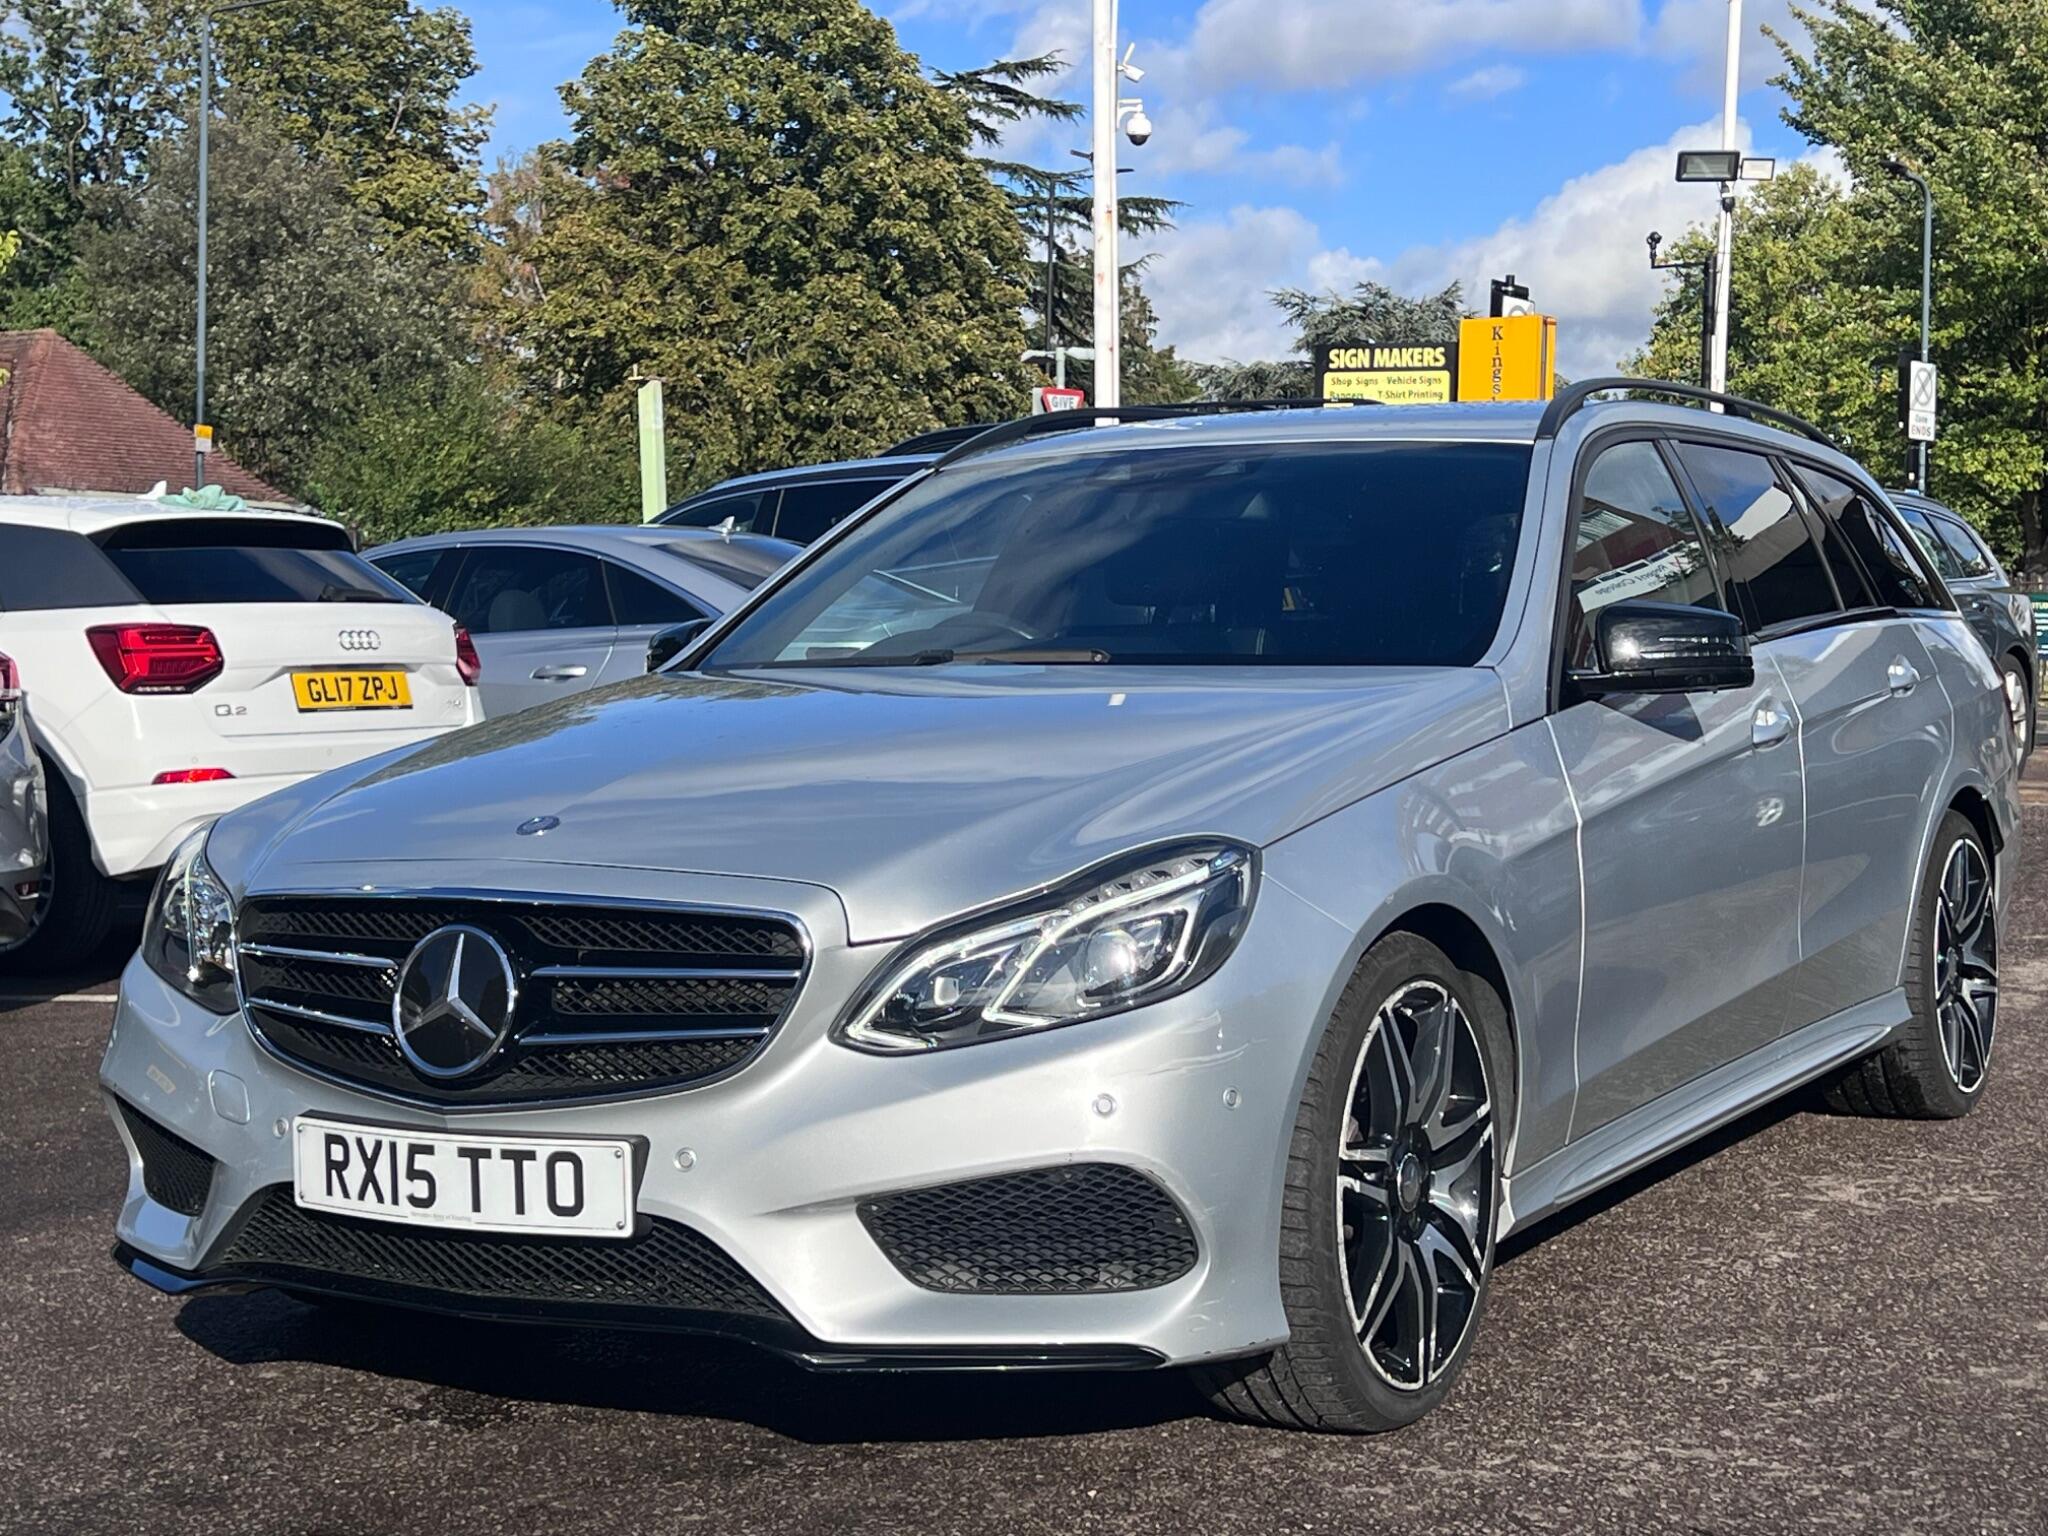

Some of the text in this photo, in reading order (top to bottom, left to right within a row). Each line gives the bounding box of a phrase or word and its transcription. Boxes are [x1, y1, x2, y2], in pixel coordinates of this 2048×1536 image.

[1328, 347, 1446, 369] SIGN MAKERS
[1492, 325, 1503, 400] Kings
[1331, 375, 1442, 387] Shop Signs Vehicle Signs
[1408, 389, 1444, 400] Printing
[1051, 396, 1075, 409] GIVE
[1911, 424, 1931, 437] ENDS
[307, 675, 398, 702] GL17 ZPJ
[215, 704, 248, 717] Q2
[324, 1132, 584, 1217] RX15 TTO
